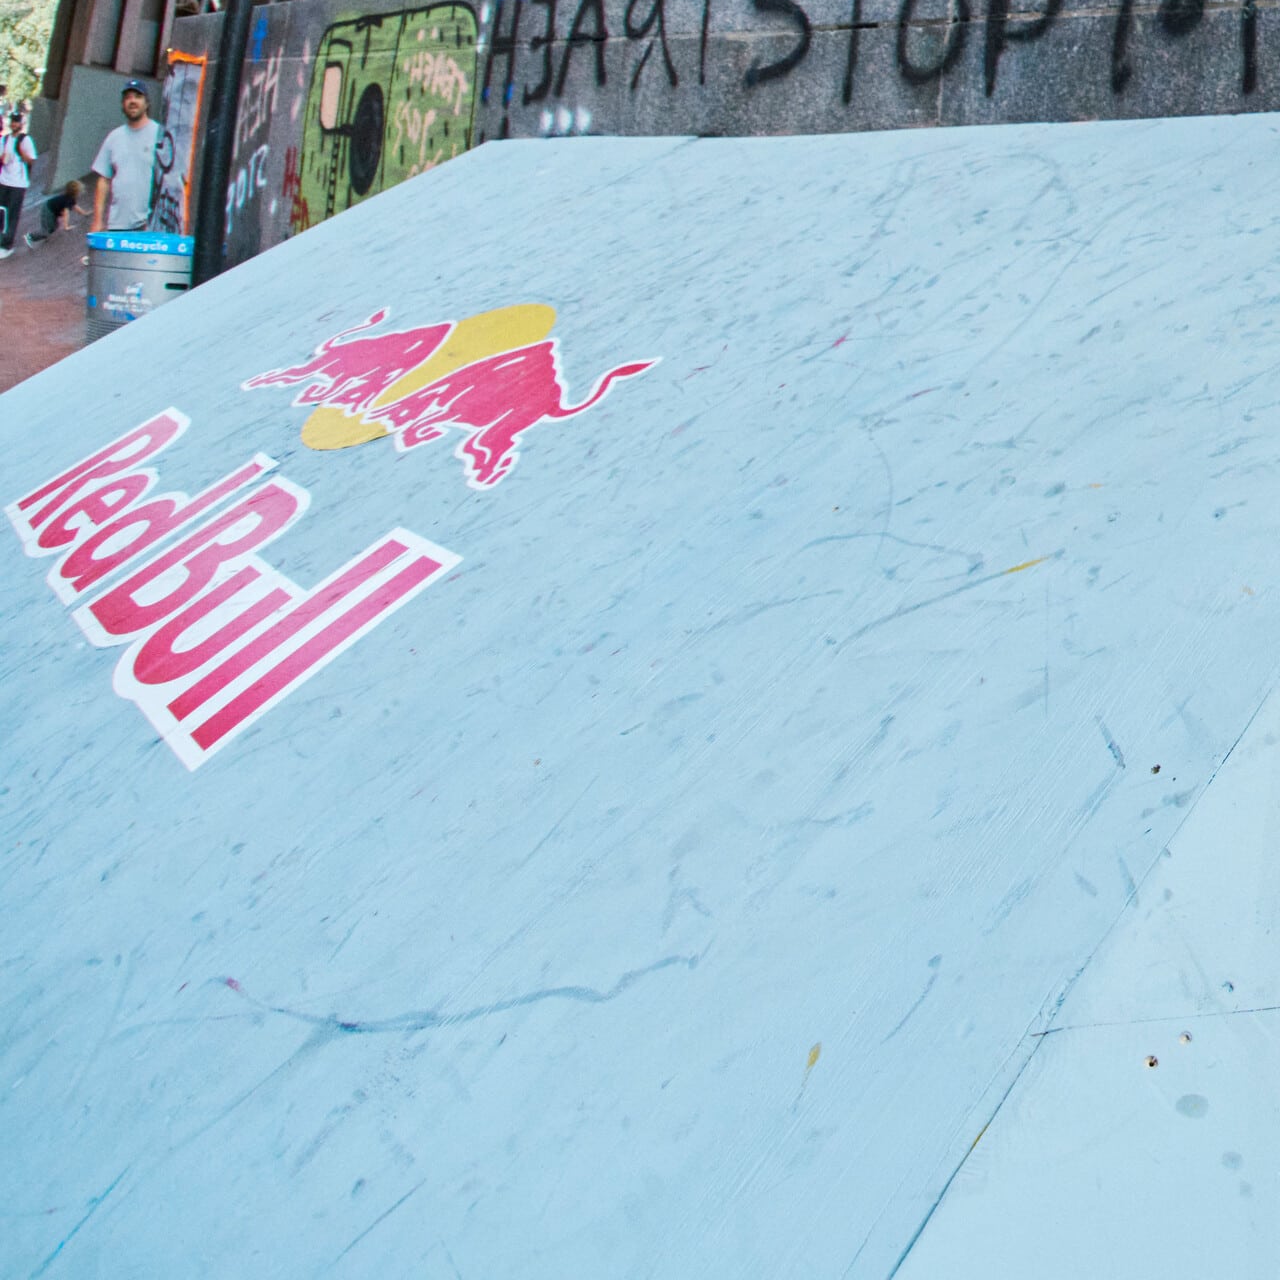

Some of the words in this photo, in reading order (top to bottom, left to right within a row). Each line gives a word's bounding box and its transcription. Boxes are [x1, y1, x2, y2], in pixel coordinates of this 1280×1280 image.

[120, 239, 169, 252] Recycle
[15, 413, 268, 594] Red
[87, 482, 444, 752] Bull
